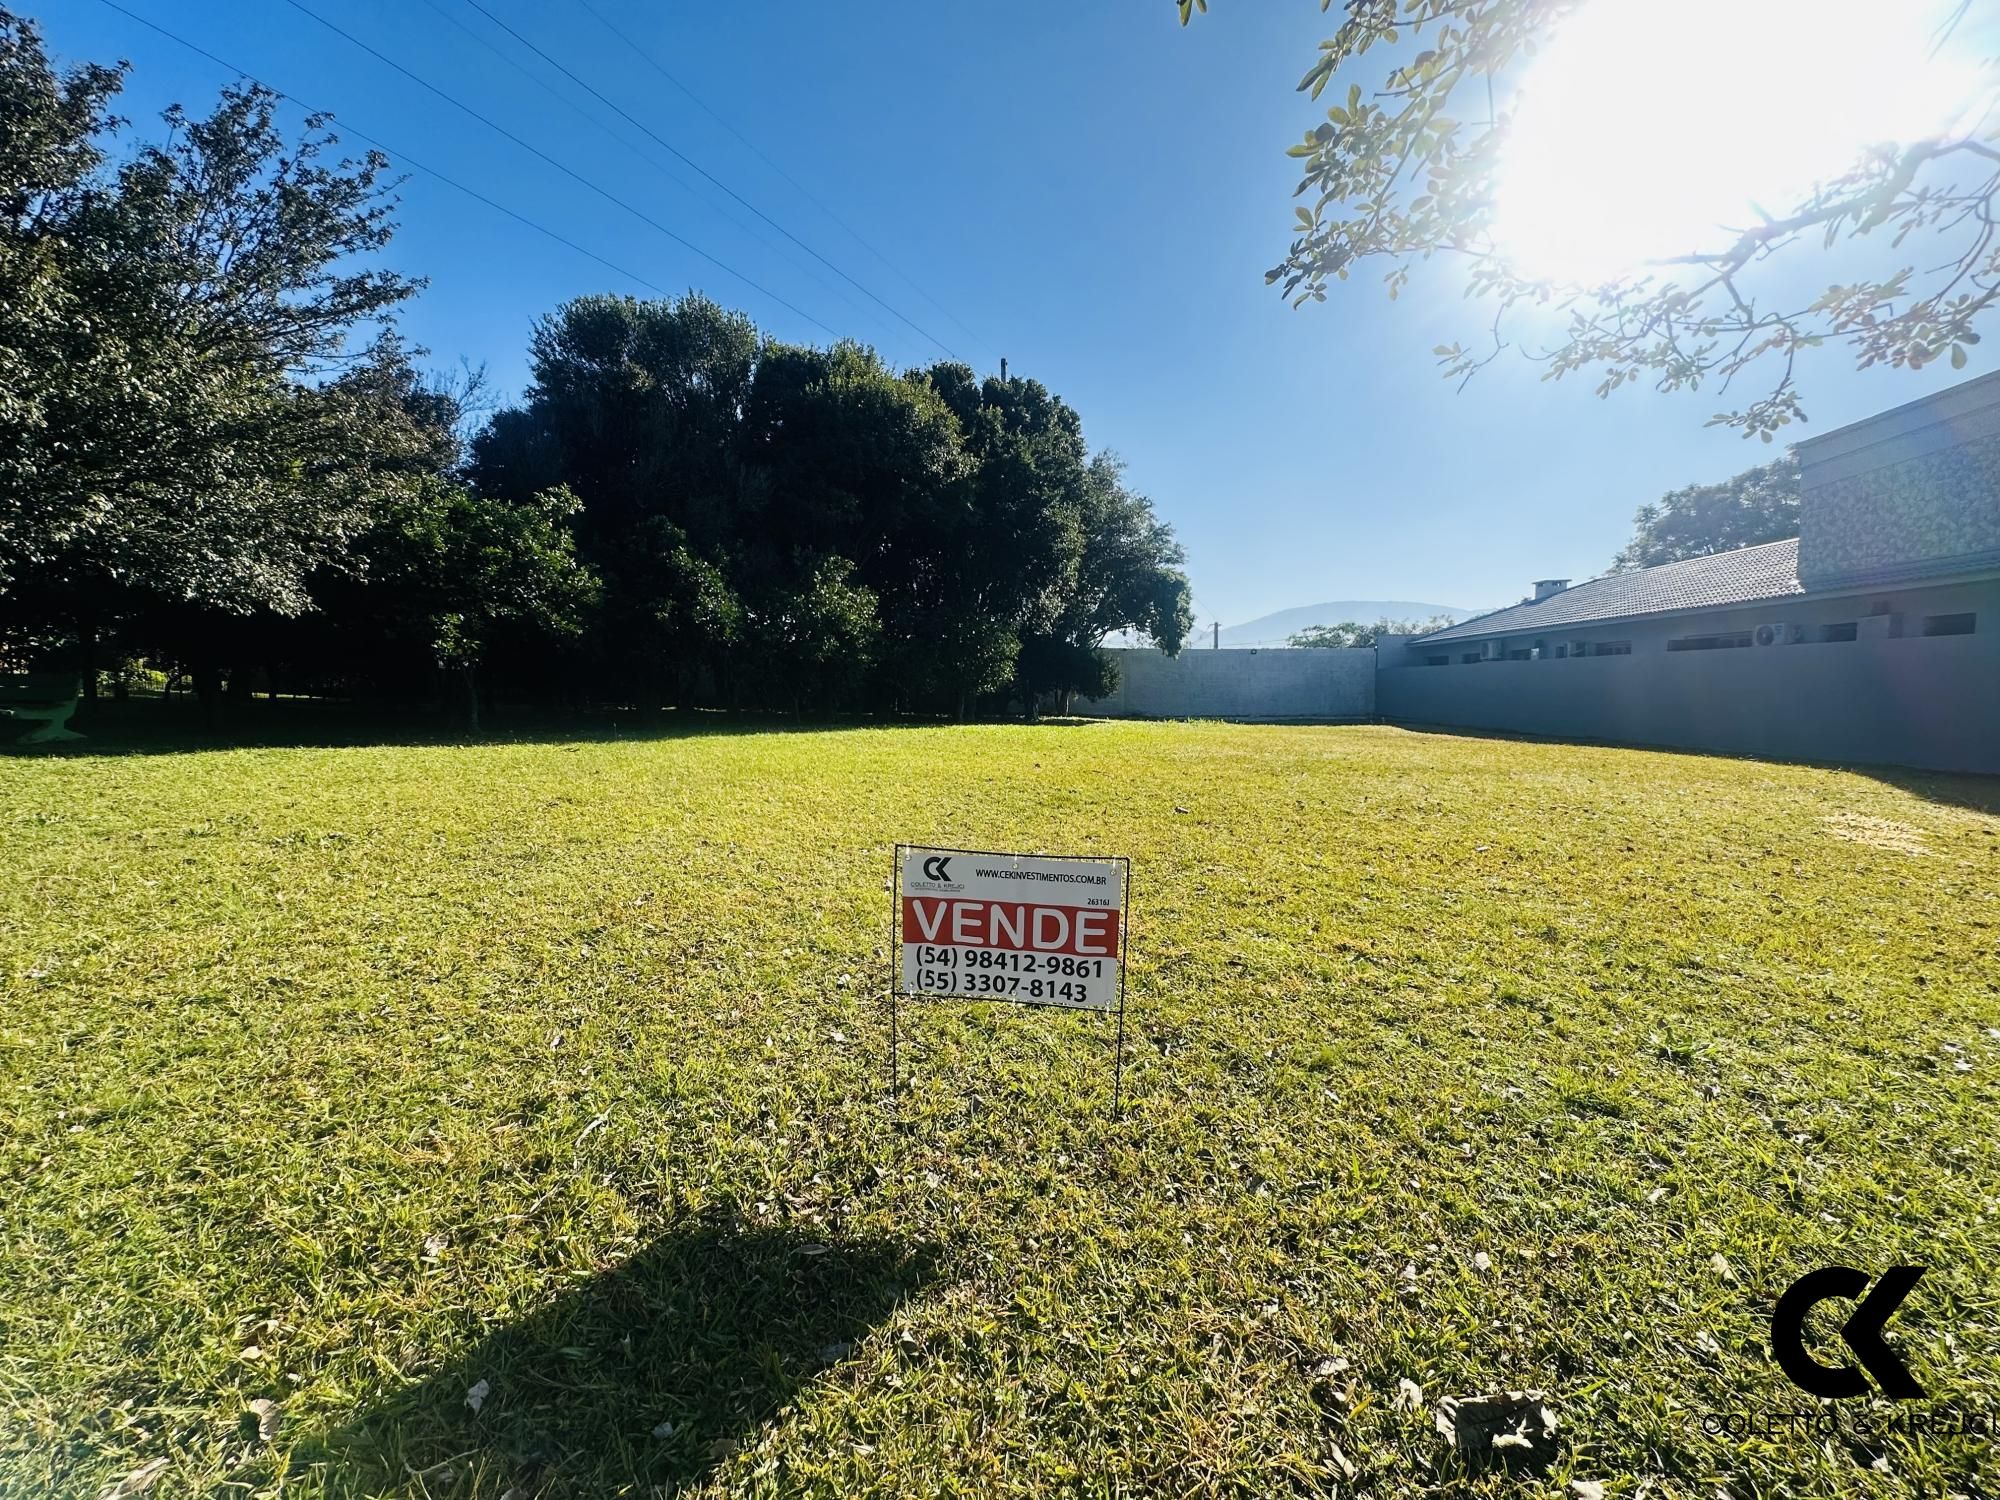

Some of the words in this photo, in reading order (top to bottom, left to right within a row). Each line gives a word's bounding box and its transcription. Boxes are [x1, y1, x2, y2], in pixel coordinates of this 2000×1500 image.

[975, 868, 1107, 885] WWW.CEKINVESTIMENTOS.COM.BR
[912, 899, 1109, 954] VENDE
[916, 945, 958, 969] (54)
[964, 949, 1103, 979] 98412-9861
[916, 968, 957, 993] (55)
[963, 973, 1087, 1003] 3307-8143
